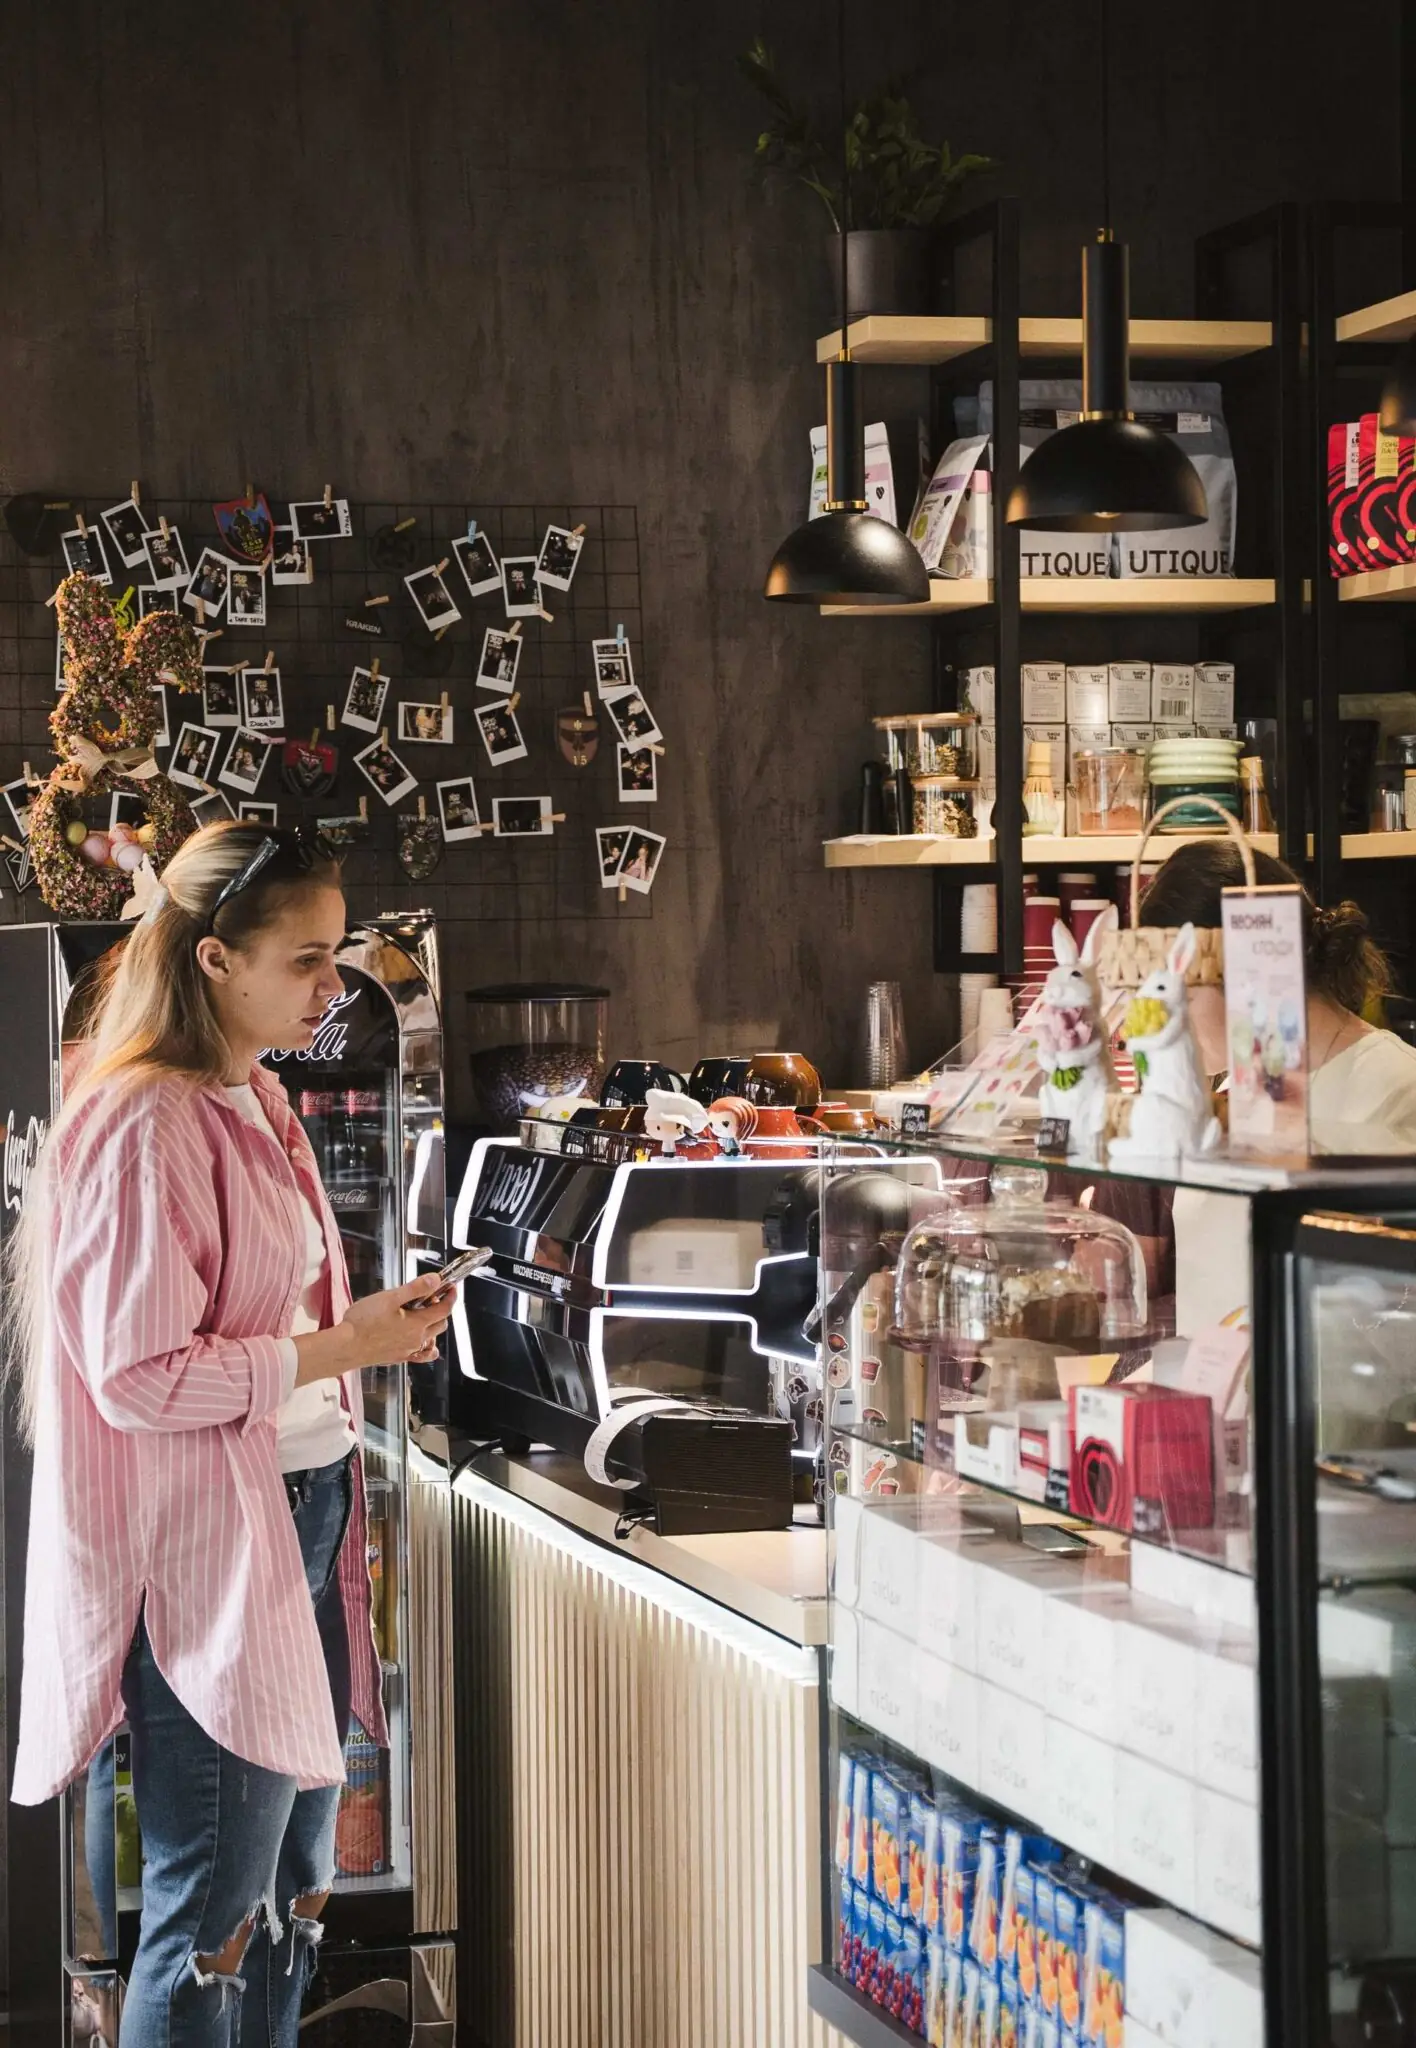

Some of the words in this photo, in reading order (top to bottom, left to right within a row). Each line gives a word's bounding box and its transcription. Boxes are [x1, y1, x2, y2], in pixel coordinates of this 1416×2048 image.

[1021, 552, 1107, 577] TIQUE
[346, 619, 381, 634] KRAKEN
[573, 755, 587, 766] 15
